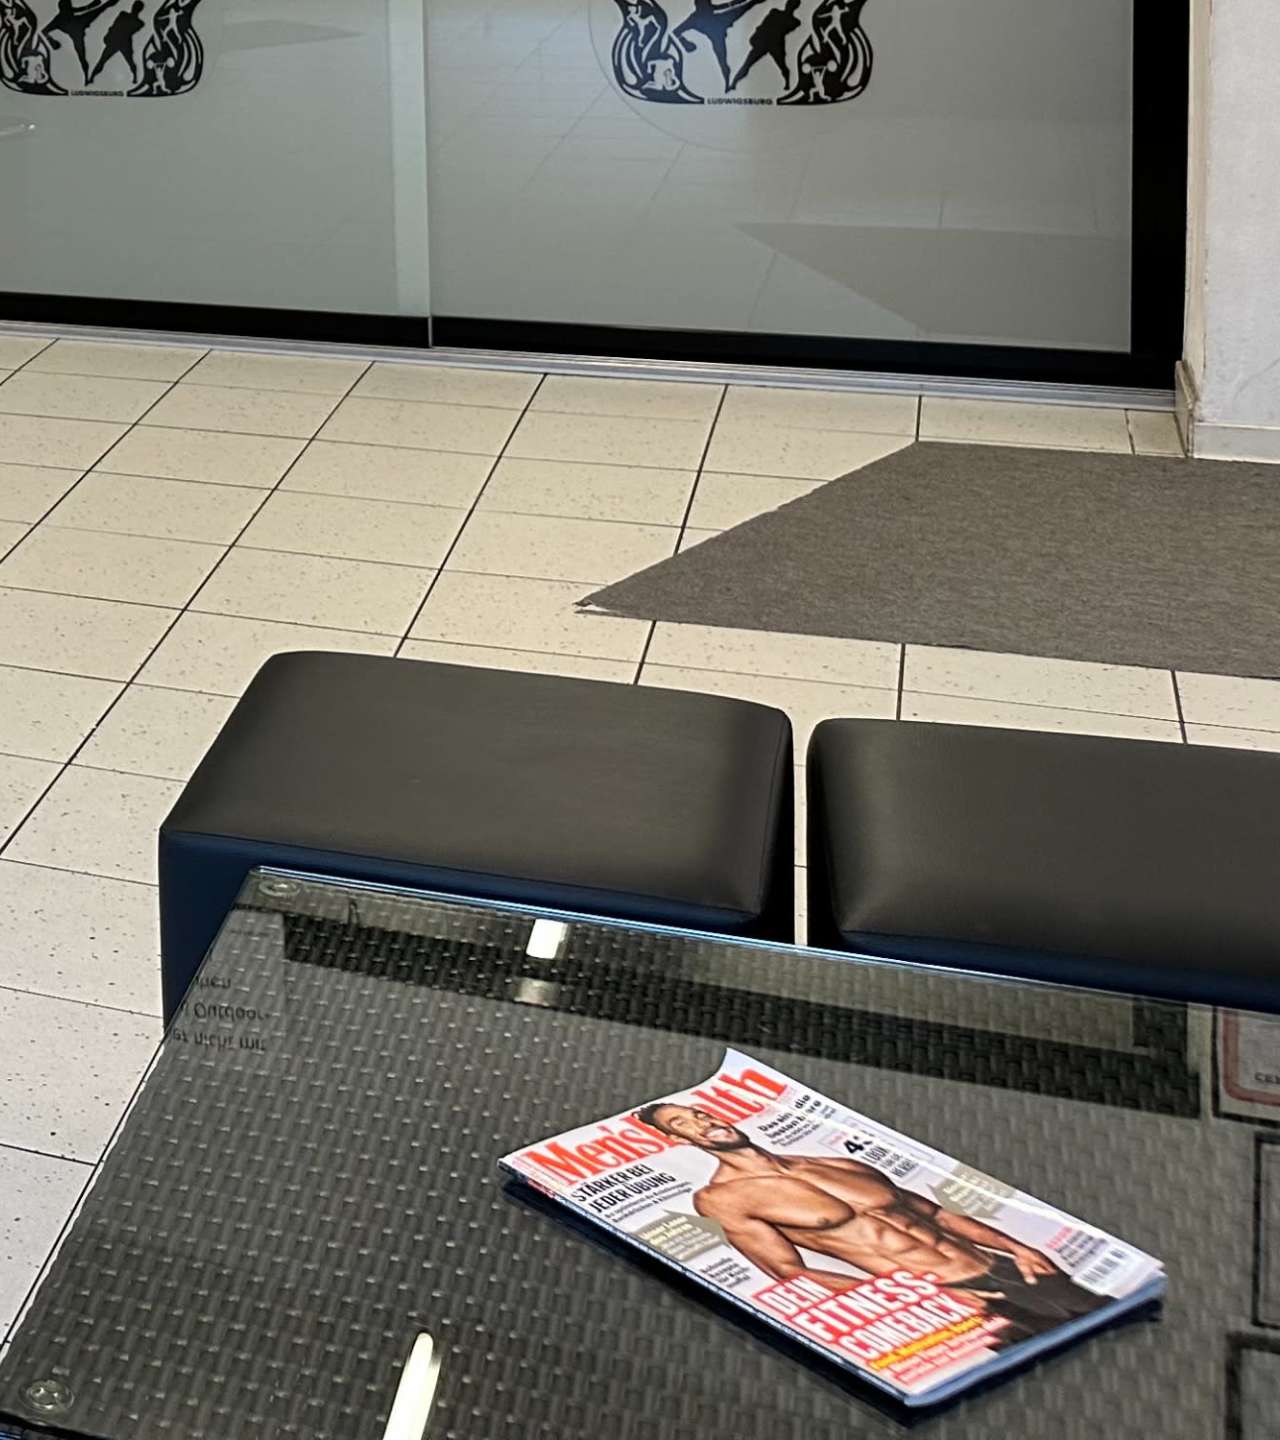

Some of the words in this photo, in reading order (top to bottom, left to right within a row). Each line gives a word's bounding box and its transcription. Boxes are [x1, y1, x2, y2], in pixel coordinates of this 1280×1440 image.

[572, 1169, 631, 1203] STÄRKER
[629, 1164, 654, 1180] BEI
[589, 1185, 629, 1213] JEDER
[627, 1172, 677, 1194] ÜBUNG
[760, 1275, 834, 1315] DEIN
[792, 1270, 939, 1342] FITNESS-
[840, 1293, 979, 1360] COMEBACK
